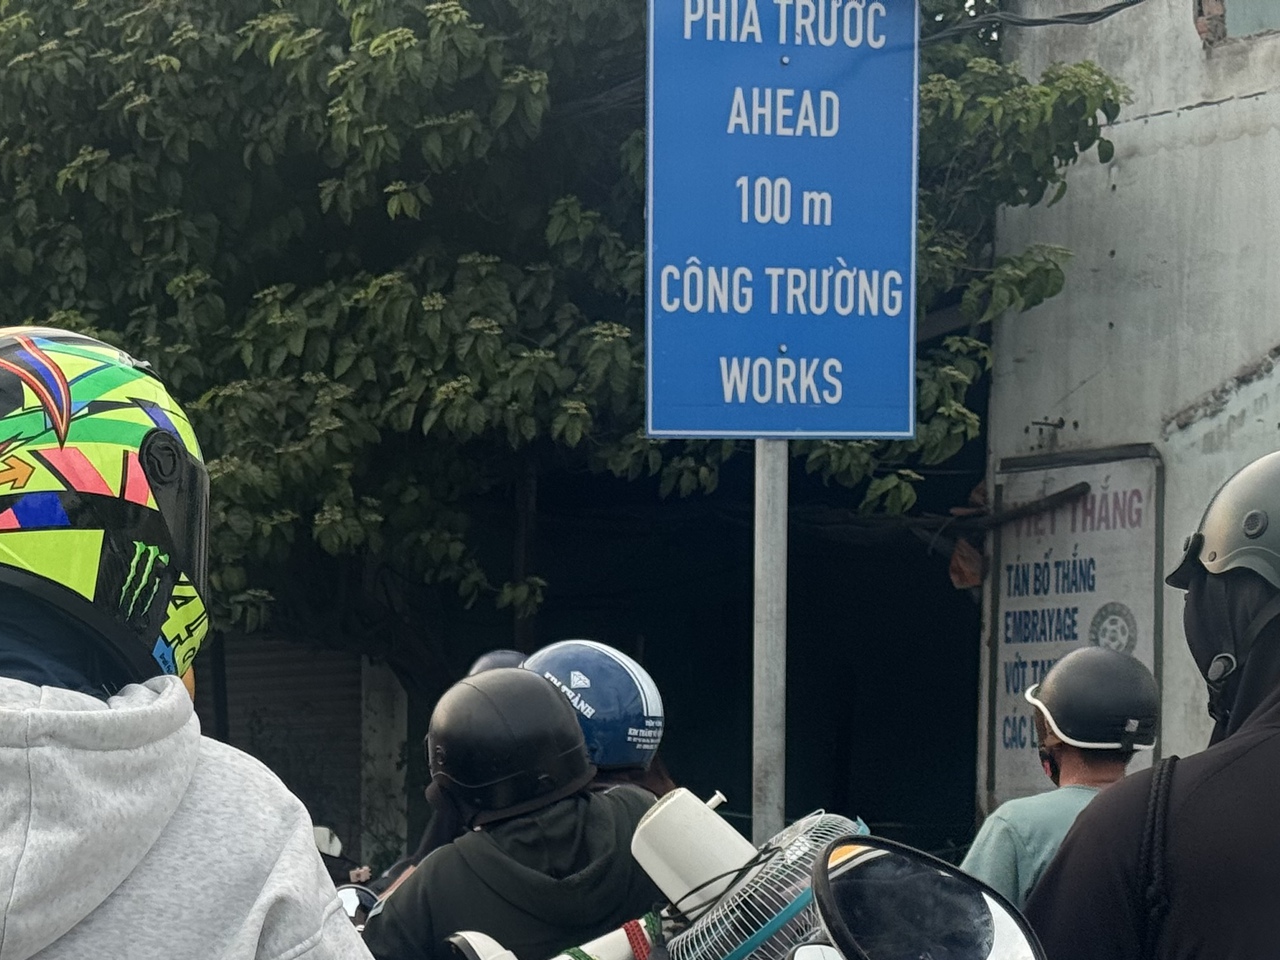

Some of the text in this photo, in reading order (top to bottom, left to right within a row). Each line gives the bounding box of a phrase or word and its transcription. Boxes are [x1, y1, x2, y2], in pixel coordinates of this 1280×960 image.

[726, 86, 840, 137] AHEAD
[736, 175, 832, 226] 100 m
[660, 256, 903, 317] CÔNG TRƯỜNG
[720, 356, 843, 405] WORKS
[1054, 542, 1096, 595] THẮNG
[1004, 607, 1079, 645] EMBRAYAGE
[1003, 707, 1027, 749] CÁC
